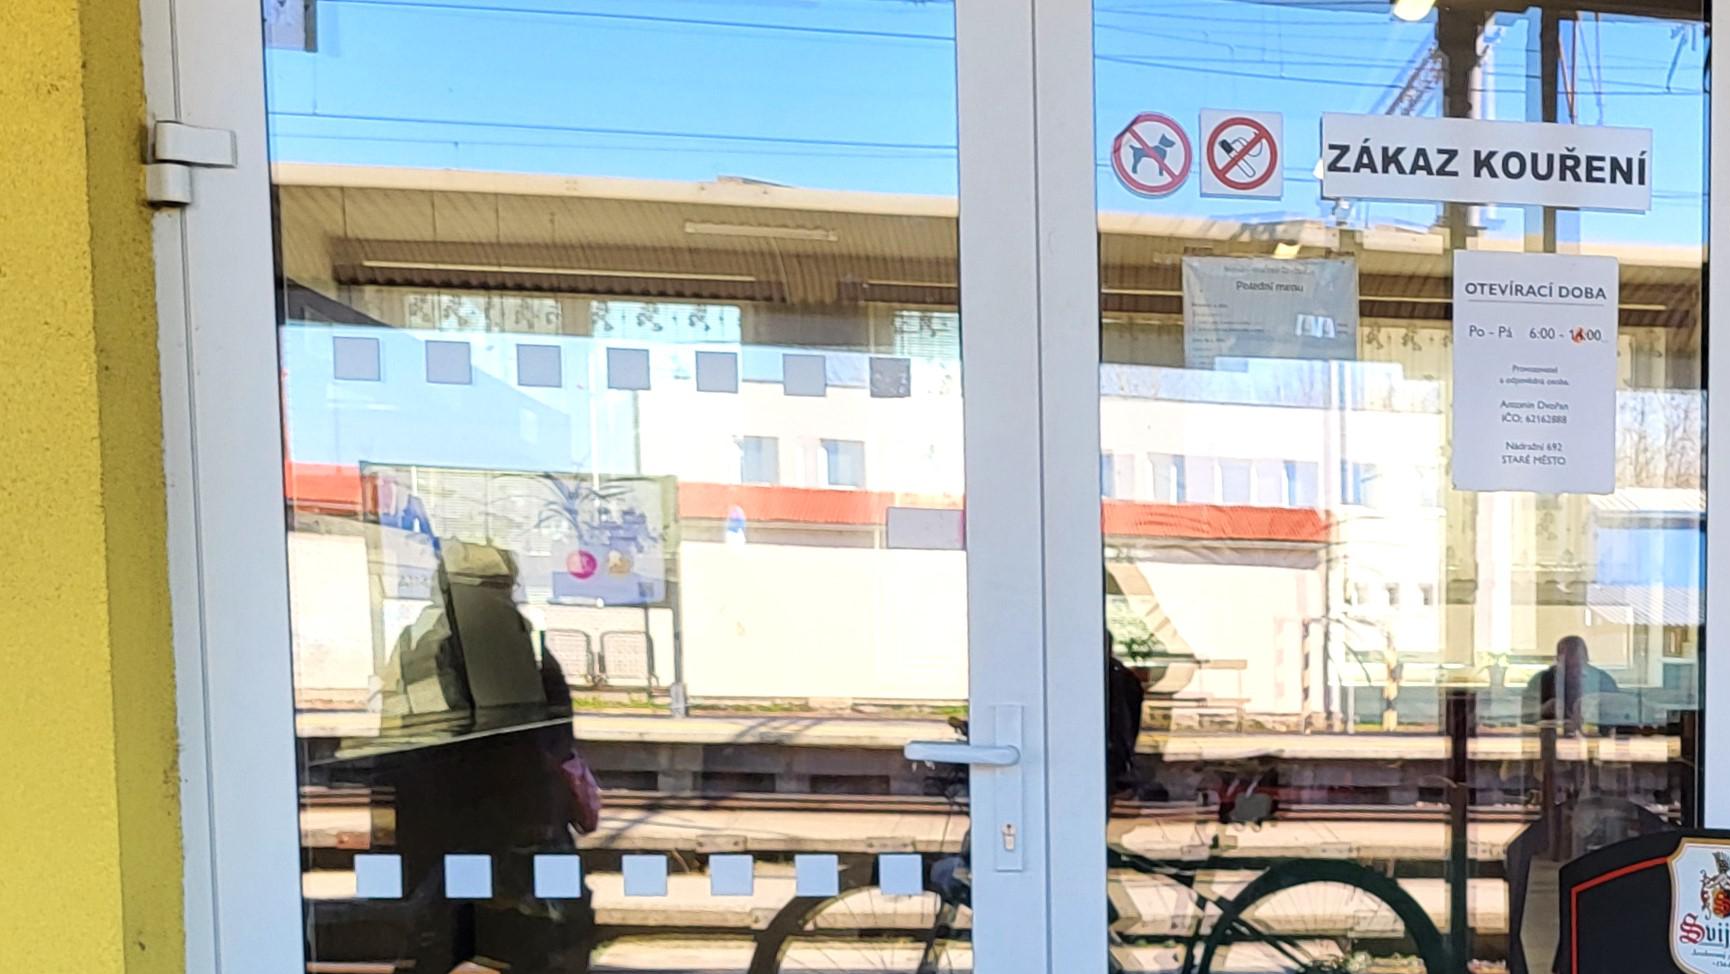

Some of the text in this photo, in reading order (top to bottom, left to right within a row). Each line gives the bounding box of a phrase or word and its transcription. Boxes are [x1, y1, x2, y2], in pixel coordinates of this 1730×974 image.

[1328, 138, 1647, 186] ZÁKAZ KOUŘENÍ
[1465, 280, 1607, 300] OTEVÍRACÍ DOBA
[1469, 324, 1485, 337] Po
[1498, 325, 1512, 338] Pá
[1502, 453, 1567, 466] STARÉ MĚSTO
